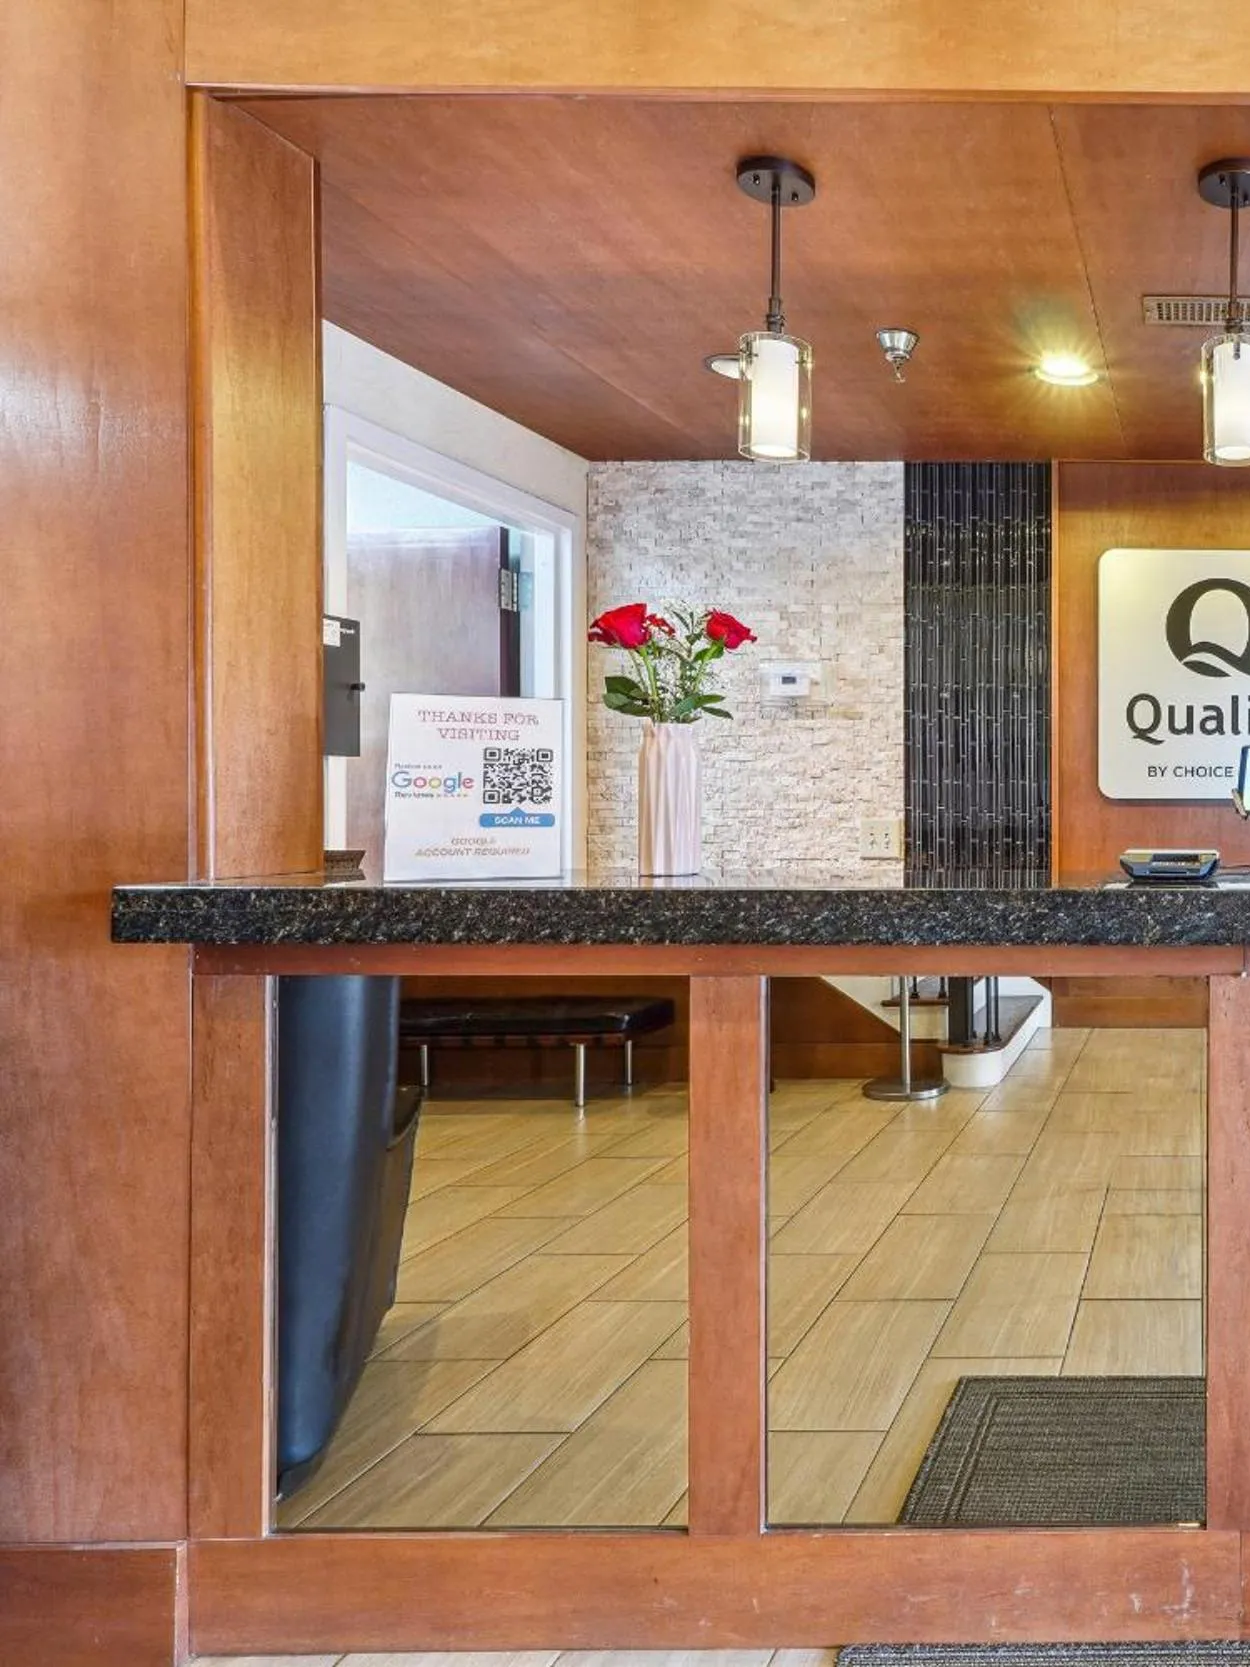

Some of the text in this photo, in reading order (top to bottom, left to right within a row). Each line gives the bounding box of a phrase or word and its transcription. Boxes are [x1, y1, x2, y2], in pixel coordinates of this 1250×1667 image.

[418, 710, 539, 725] THANKS FOR
[437, 728, 520, 741] VISITING
[1147, 766, 1234, 777] BY CHOICE
[391, 771, 475, 793] Google
[414, 847, 472, 857] ACCOUNT
